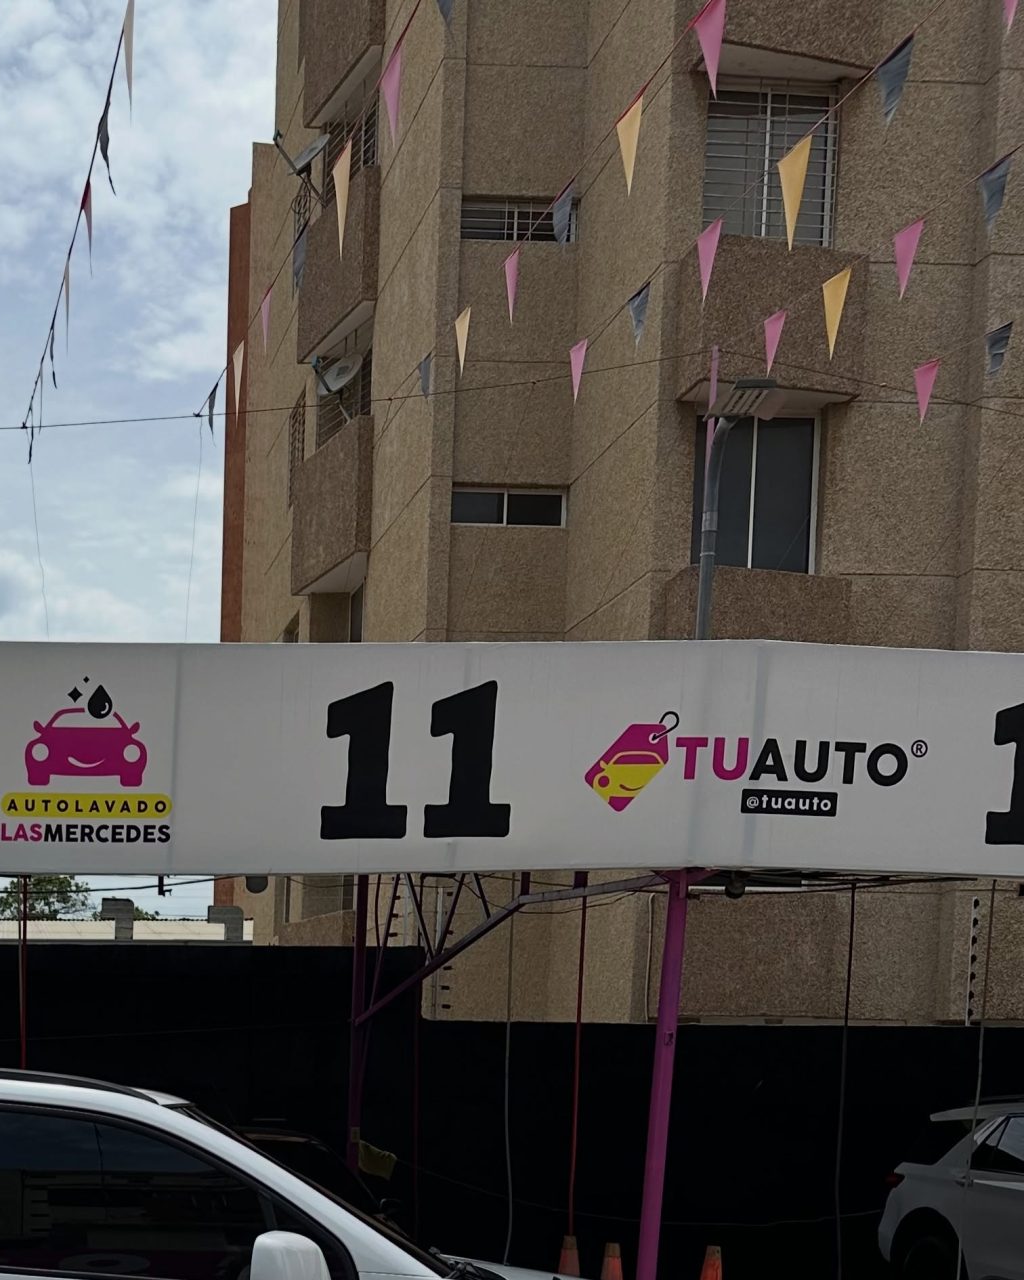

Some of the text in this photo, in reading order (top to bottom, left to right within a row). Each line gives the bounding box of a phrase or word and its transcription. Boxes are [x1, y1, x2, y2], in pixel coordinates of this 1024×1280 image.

[319, 679, 511, 840] 11
[6, 798, 168, 814] AUTOLAVADO
[745, 793, 833, 812] @tuauto
